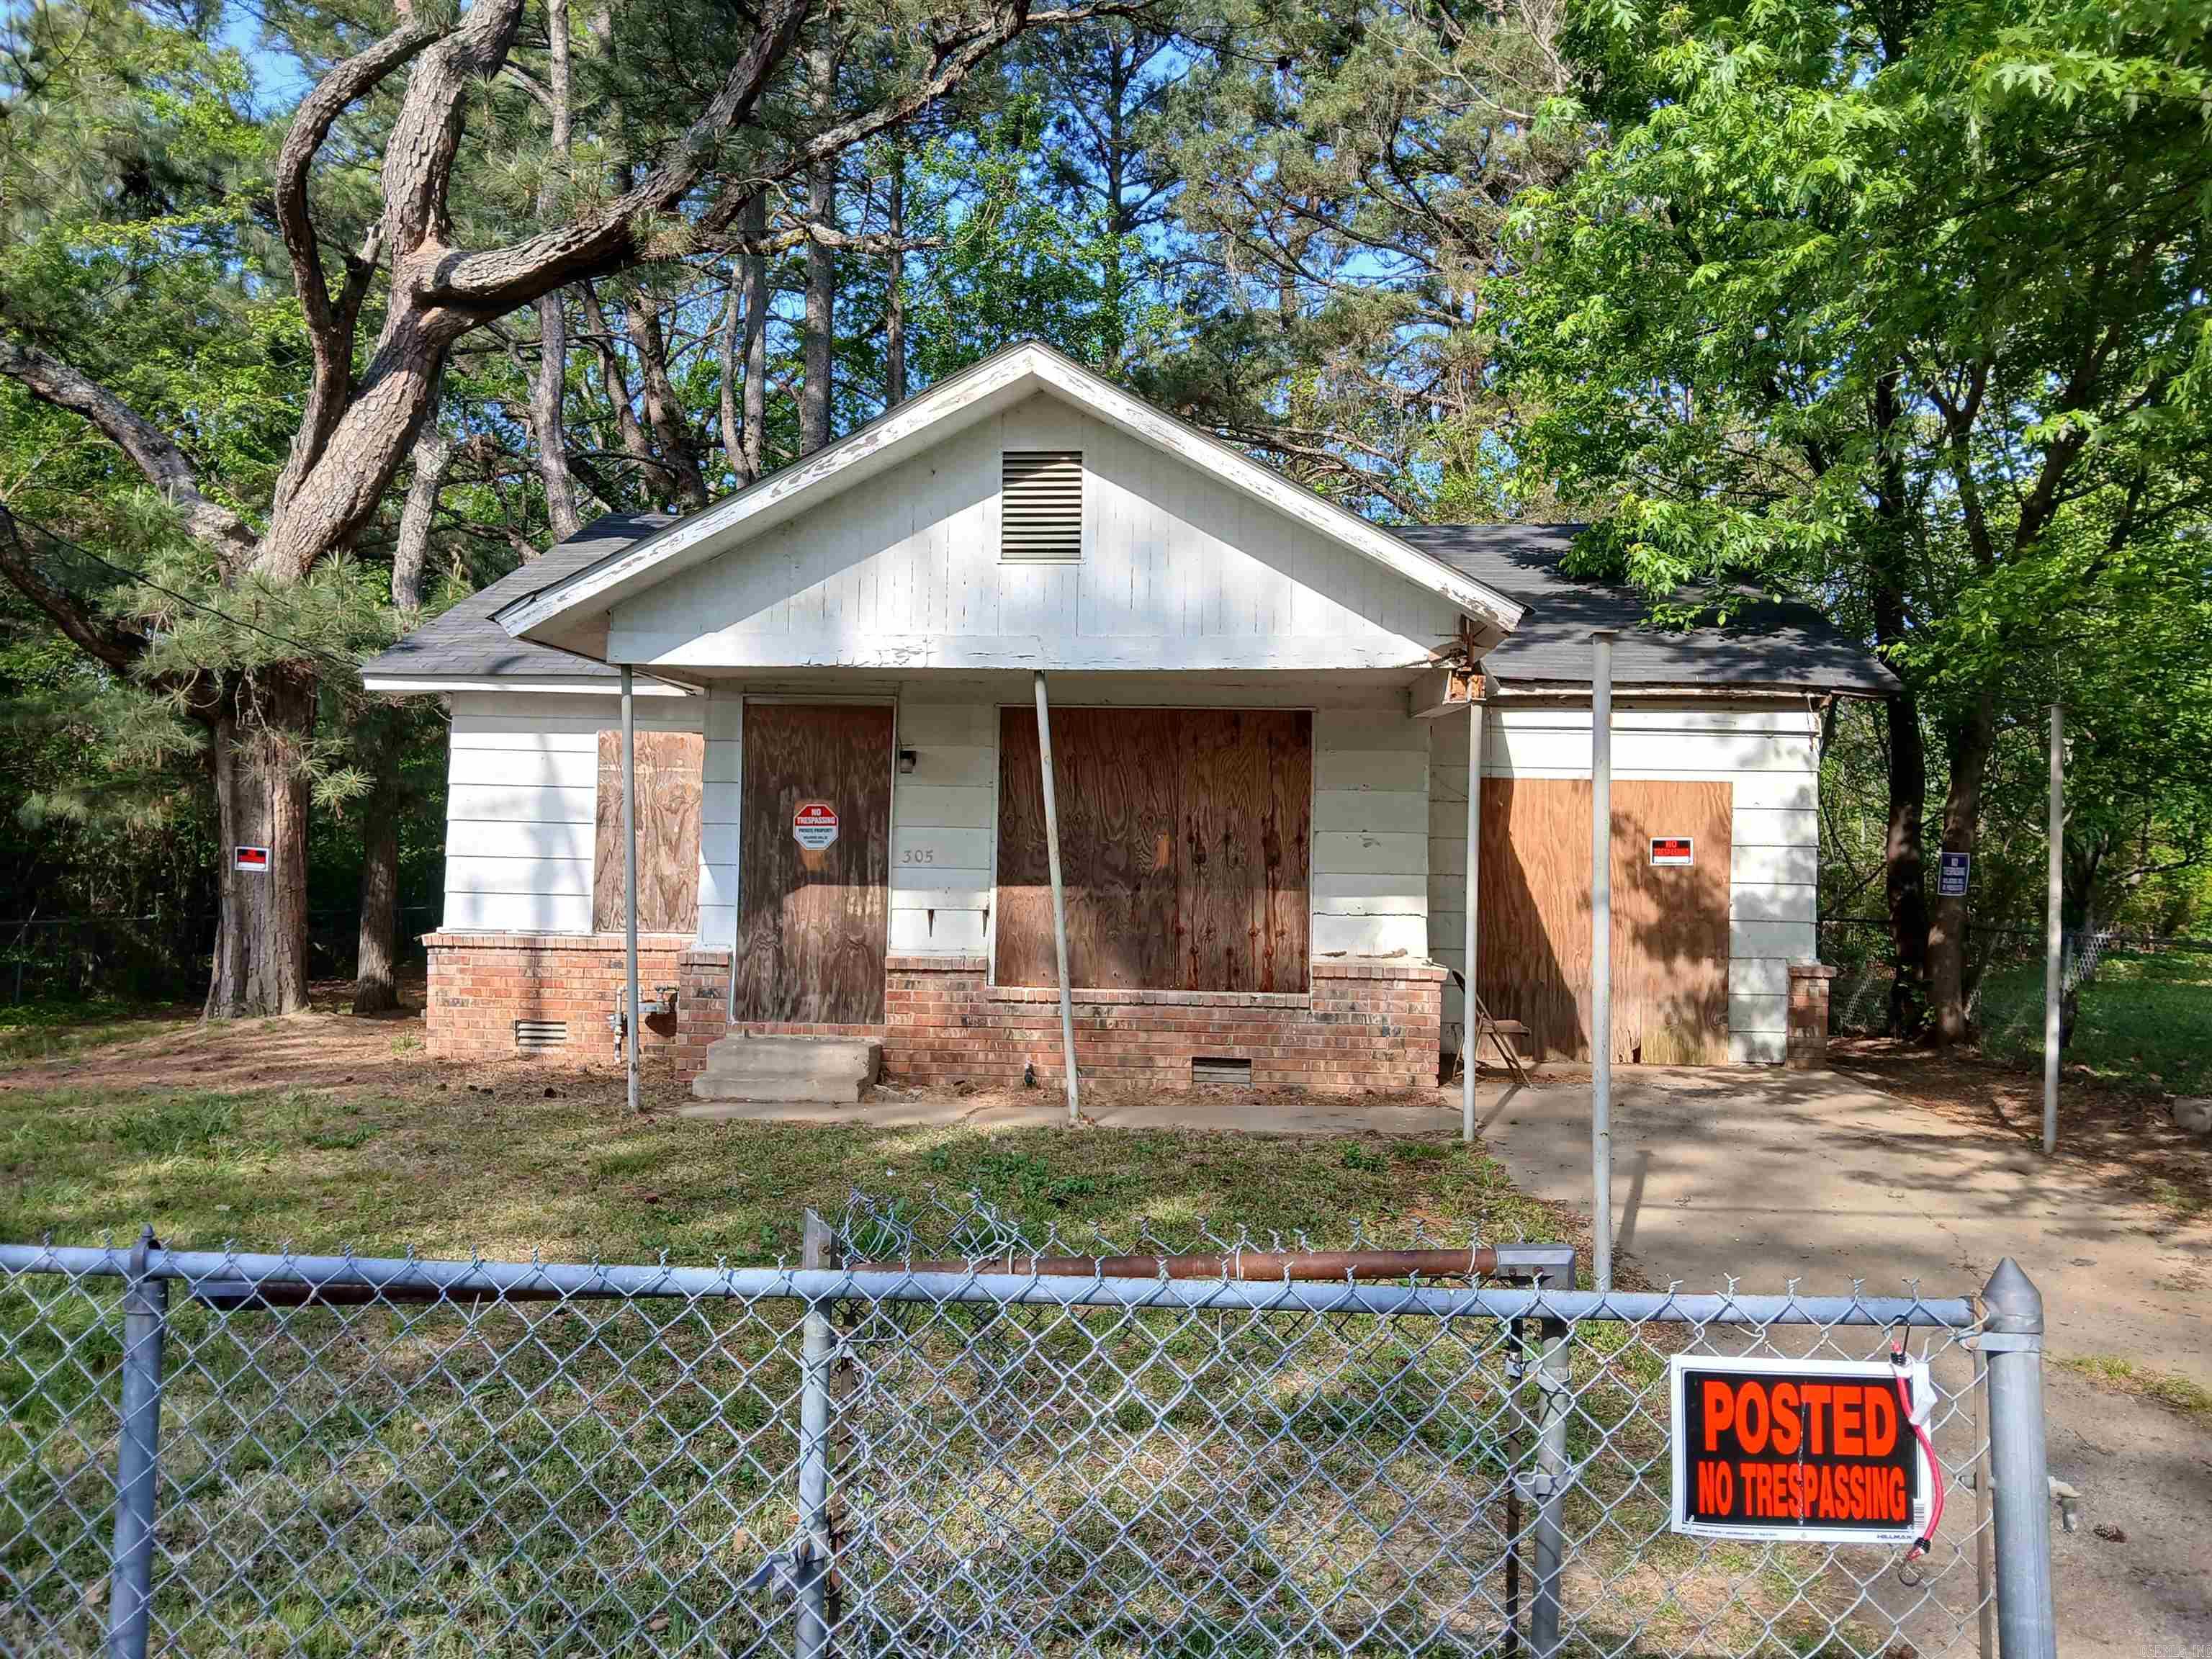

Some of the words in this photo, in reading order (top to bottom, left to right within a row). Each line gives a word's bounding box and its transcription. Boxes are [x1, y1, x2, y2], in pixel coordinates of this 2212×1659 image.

[901, 850, 934, 863] 305
[1703, 1380, 1897, 1457] POSTED
[1698, 1461, 1733, 1516] NO
[1740, 1462, 1907, 1521] TRESPASSING
